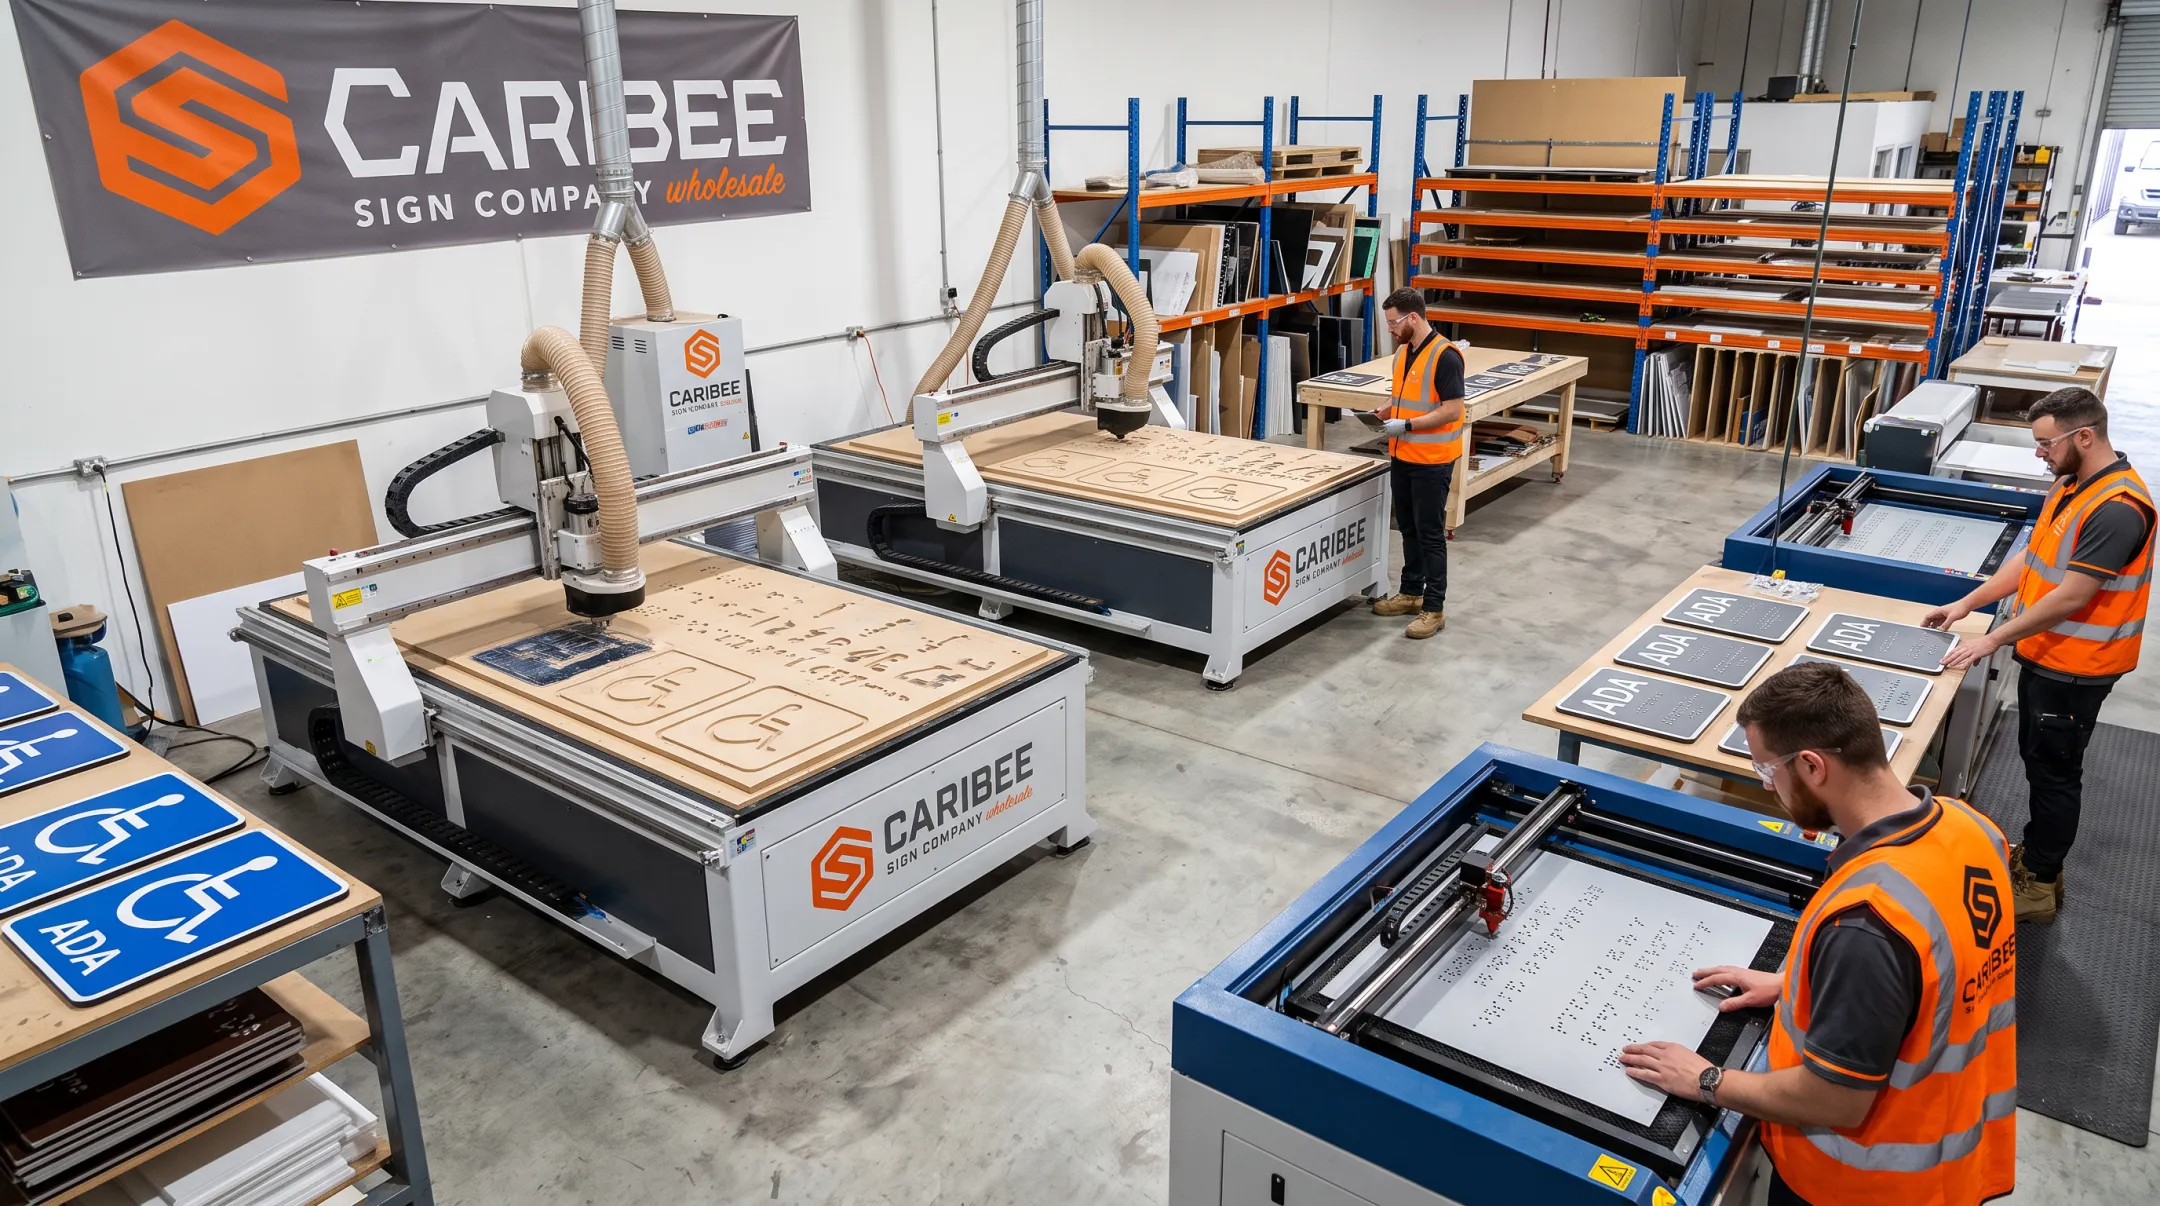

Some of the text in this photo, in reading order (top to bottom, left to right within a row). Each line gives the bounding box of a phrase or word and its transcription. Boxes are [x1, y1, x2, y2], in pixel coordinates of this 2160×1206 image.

[354, 162, 786, 228] SIGN COMPAY wholesale
[669, 380, 741, 407] CARIBEE
[1295, 517, 1366, 574] CARIBEE
[1295, 573, 1310, 588] SIGN
[1683, 595, 1738, 624] ADA
[1637, 633, 1698, 666] ADA
[1826, 622, 1881, 653] ADA
[1581, 678, 1649, 716] ADA
[884, 741, 1034, 855] CARIBEE
[886, 848, 918, 875] SIGN
[923, 811, 983, 855] COMPANY
[0, 845, 37, 893] DA
[38, 919, 122, 977] ADA
[1962, 933, 2015, 1004] CARIBEE
